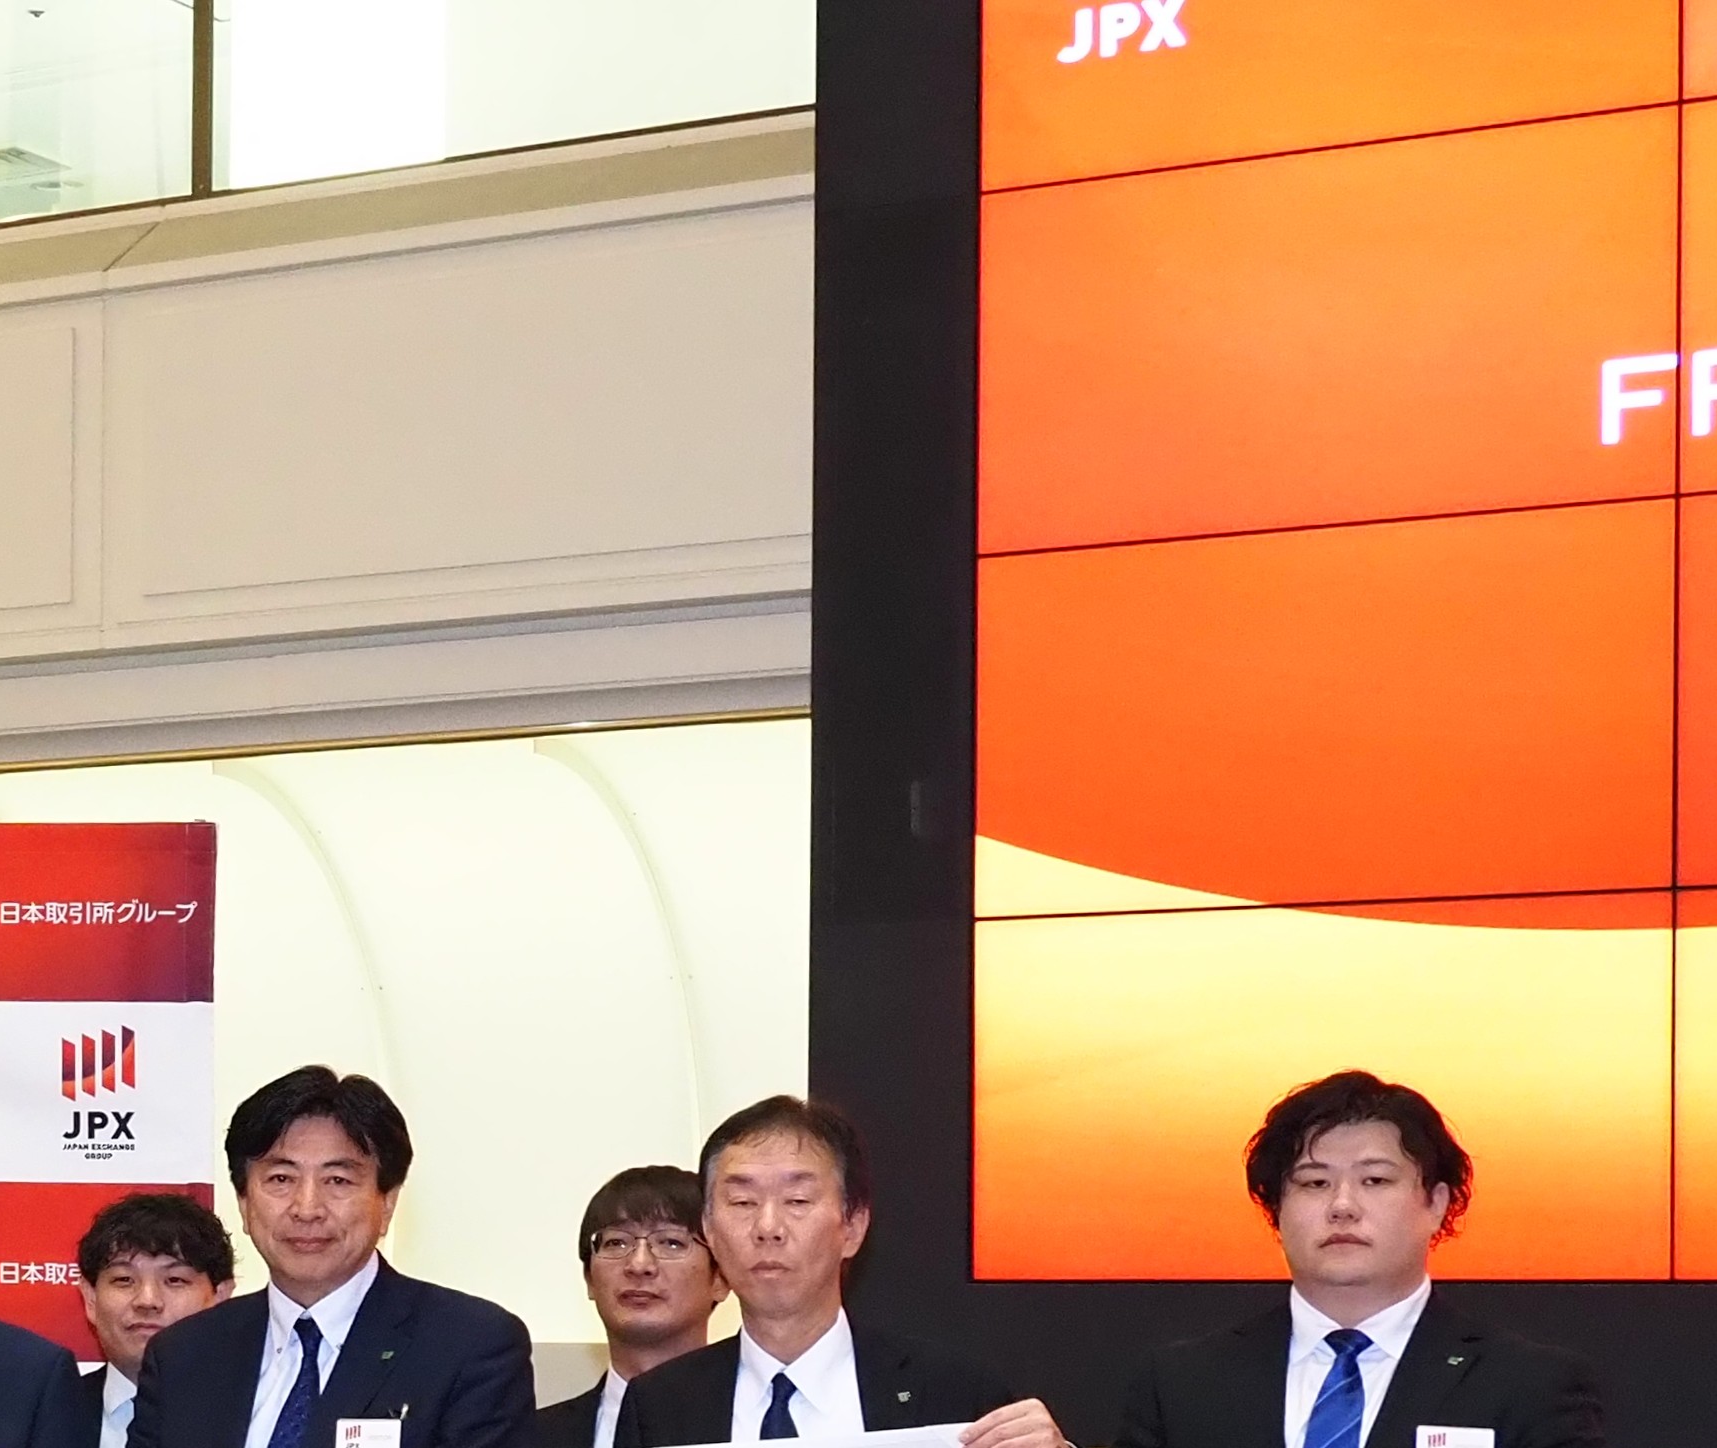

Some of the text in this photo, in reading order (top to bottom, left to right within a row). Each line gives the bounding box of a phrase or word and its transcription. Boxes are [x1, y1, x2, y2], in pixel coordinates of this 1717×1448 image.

[1057, 0, 1187, 63] JPX
[0, 898, 198, 925] 日本取引所グループ
[62, 1111, 135, 1140] JPX
[91, 1143, 135, 1151] EXCHANGE
